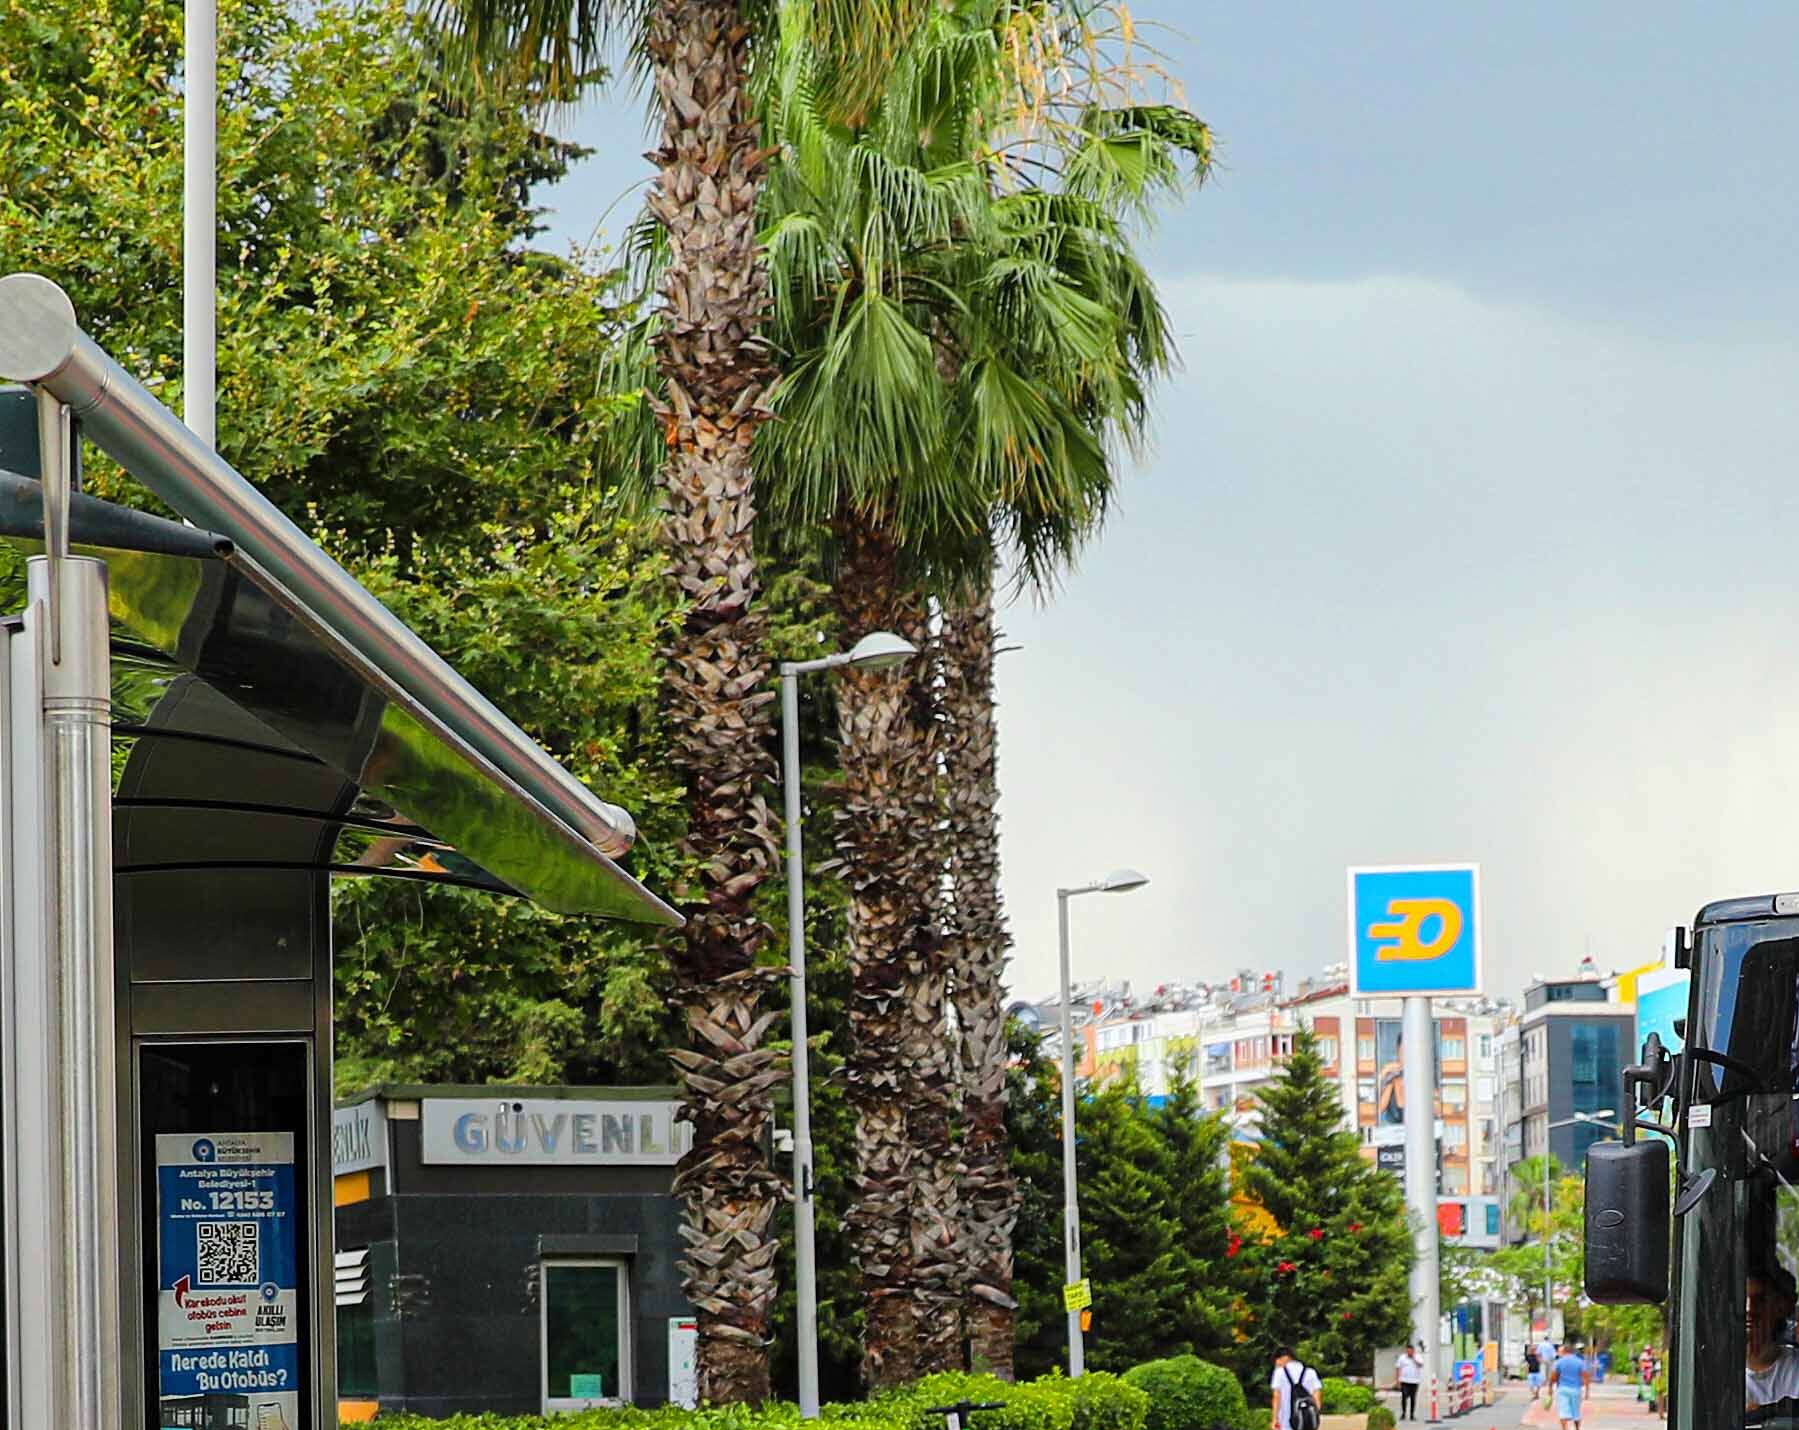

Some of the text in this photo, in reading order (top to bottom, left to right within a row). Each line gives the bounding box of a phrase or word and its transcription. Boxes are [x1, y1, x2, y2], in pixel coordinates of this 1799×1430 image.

[180, 1191, 274, 1211] No. 12153
[171, 1350, 269, 1372] Nerede Kaldı
[195, 1369, 288, 1391] Bu Otobüs?
